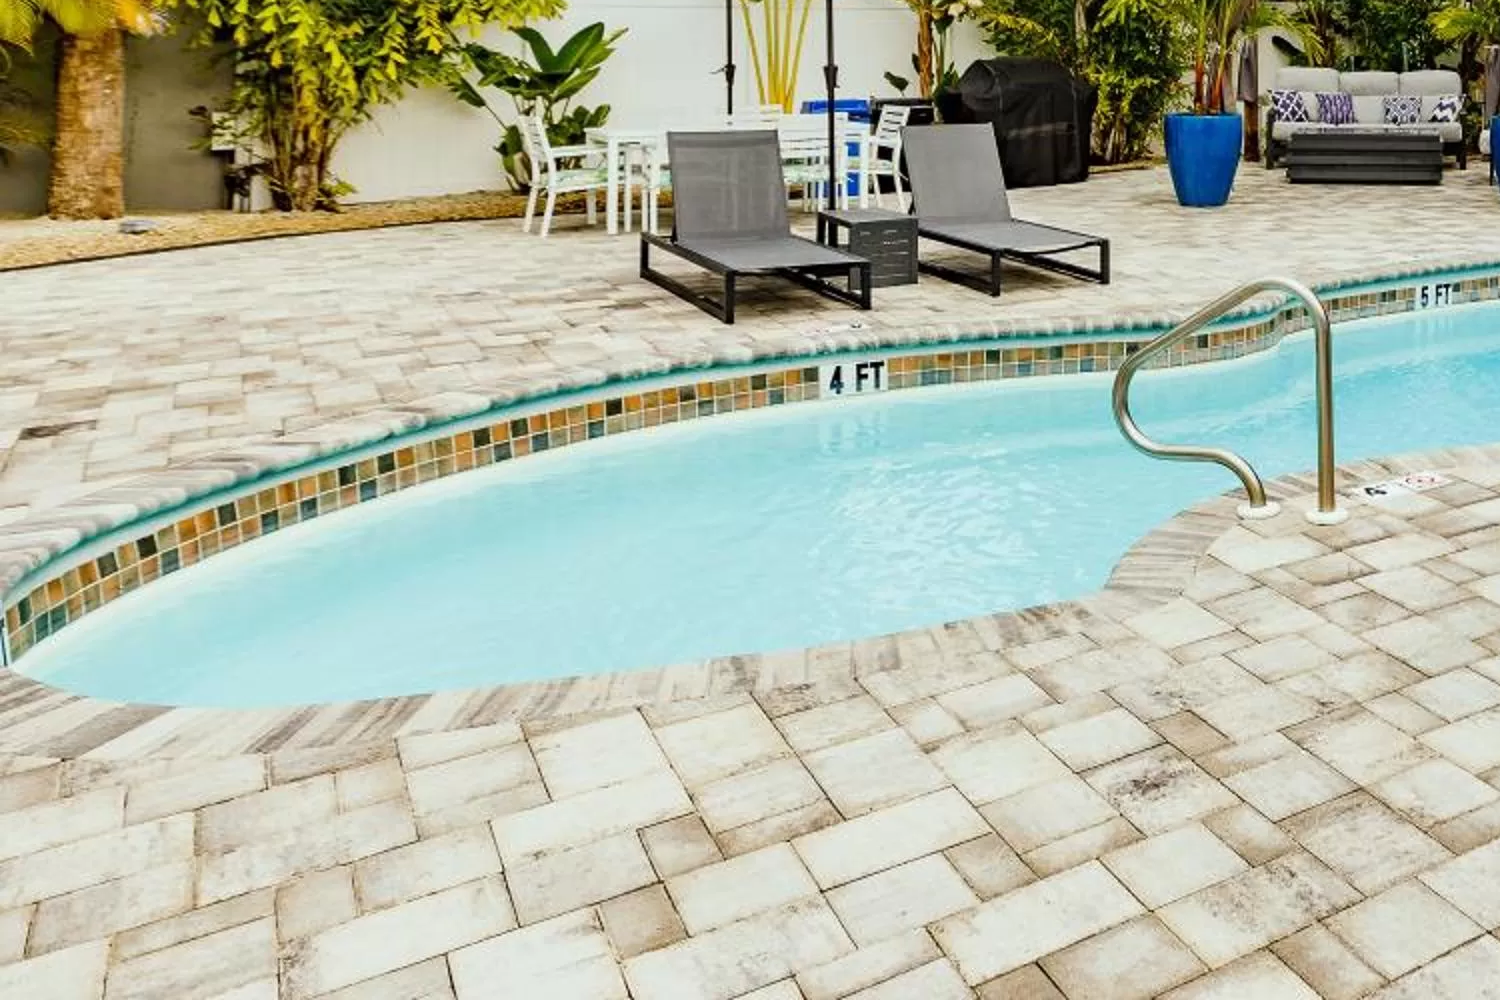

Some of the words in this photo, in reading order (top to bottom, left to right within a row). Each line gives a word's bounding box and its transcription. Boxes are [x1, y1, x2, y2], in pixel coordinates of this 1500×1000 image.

[1421, 286, 1429, 307] 5
[1435, 283, 1451, 305] FT
[830, 365, 844, 394] 4
[855, 361, 884, 392] FT
